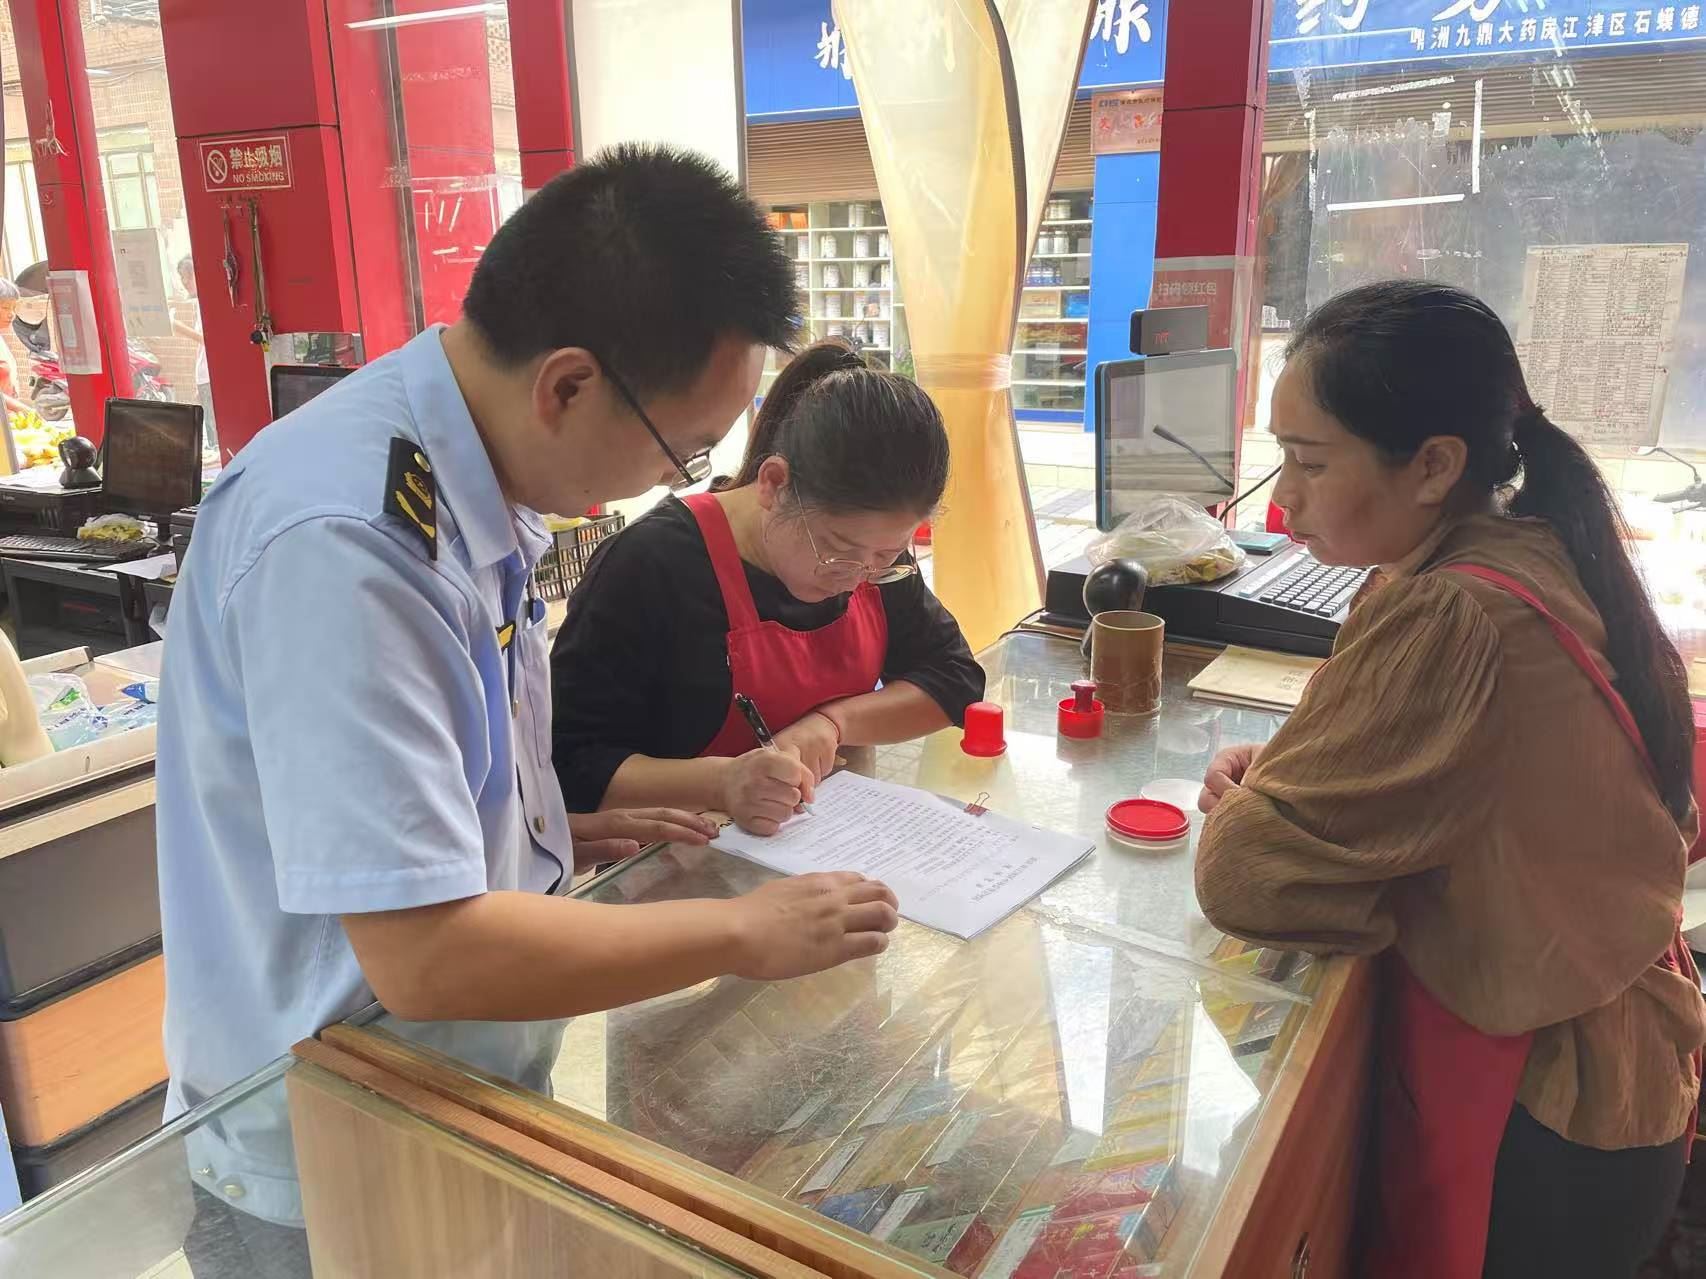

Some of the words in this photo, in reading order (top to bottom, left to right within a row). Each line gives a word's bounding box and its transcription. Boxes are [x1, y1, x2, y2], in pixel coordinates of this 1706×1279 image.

[229, 144, 283, 170] 禁止吸烟
[232, 174, 245, 183] NO
